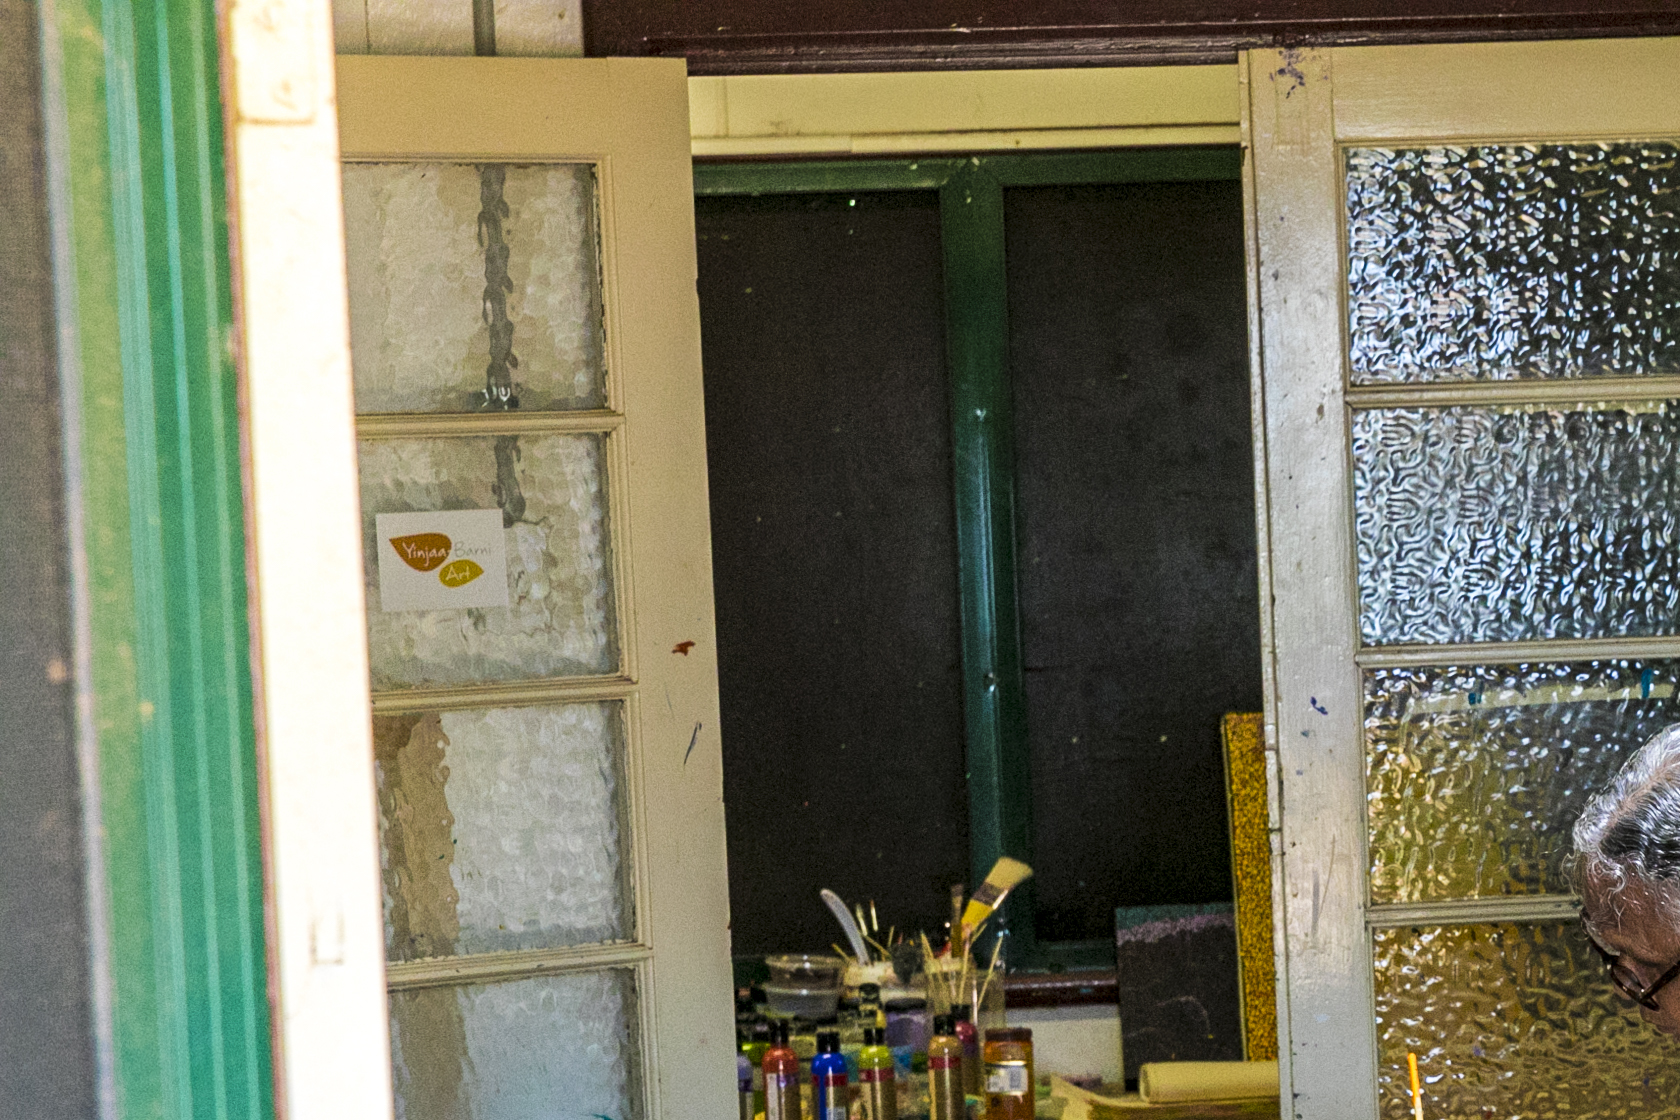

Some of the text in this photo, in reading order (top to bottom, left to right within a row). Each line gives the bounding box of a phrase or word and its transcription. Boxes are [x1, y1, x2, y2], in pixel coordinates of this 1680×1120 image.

[402, 541, 492, 566] Yinjaa Barni
[445, 565, 471, 581] Art
